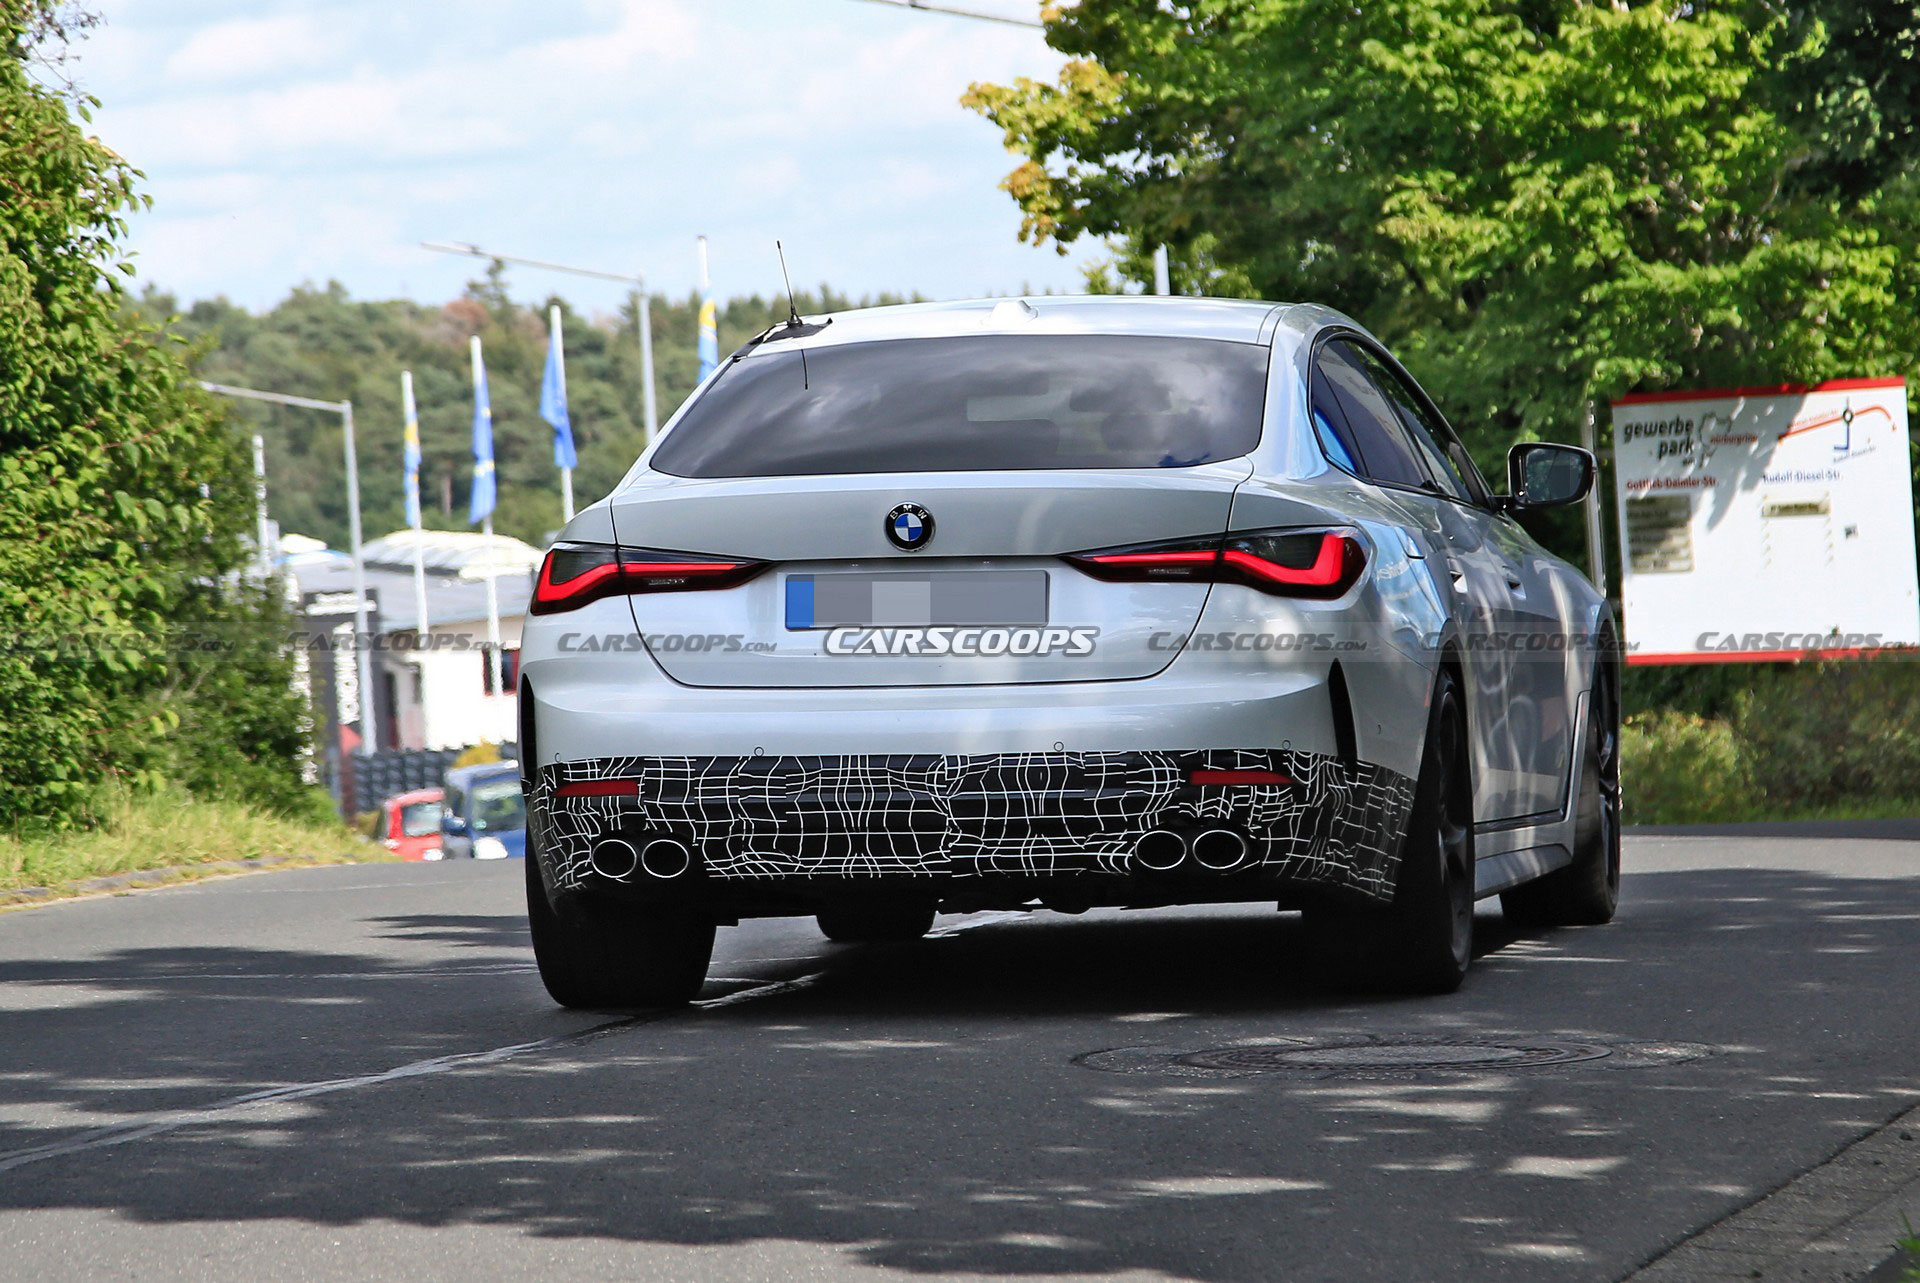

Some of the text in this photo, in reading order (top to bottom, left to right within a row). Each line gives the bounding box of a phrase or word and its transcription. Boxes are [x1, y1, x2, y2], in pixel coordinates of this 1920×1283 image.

[1624, 415, 1694, 443] gewerbe
[1658, 436, 1695, 460] park
[889, 504, 928, 520] BMW
